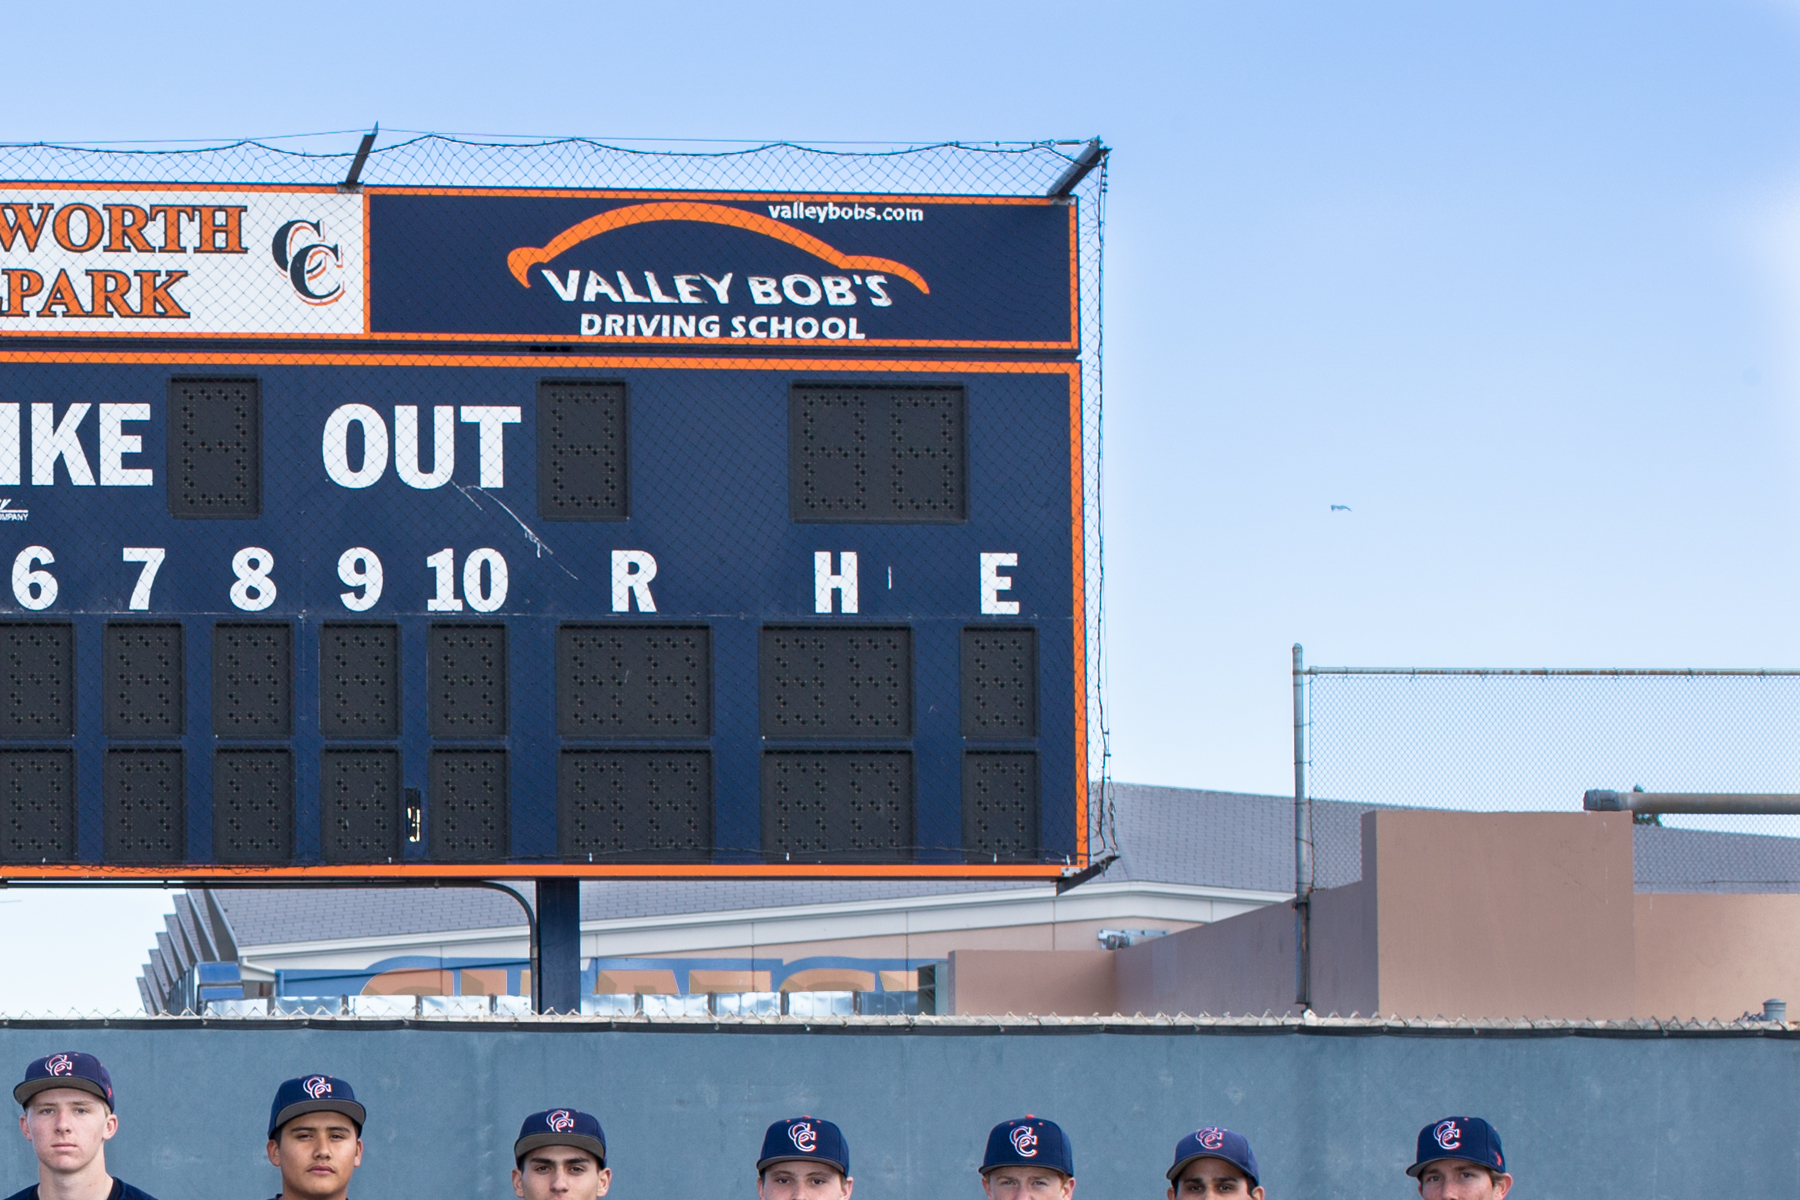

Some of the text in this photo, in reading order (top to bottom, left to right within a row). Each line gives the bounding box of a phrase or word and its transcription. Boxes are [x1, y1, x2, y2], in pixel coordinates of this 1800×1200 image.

[768, 201, 924, 224] valleybobs.com
[541, 269, 892, 307] VALLEY BOB'S
[580, 313, 866, 341] DRIVING SCHOOL
[322, 403, 522, 490] OUT
[11, 545, 59, 610] 6
[122, 547, 166, 610] 7
[229, 546, 277, 611] 8
[337, 546, 384, 612] 9
[426, 547, 509, 613] 10
[611, 549, 658, 612] R
[814, 551, 859, 614] H
[980, 552, 1020, 615] E
